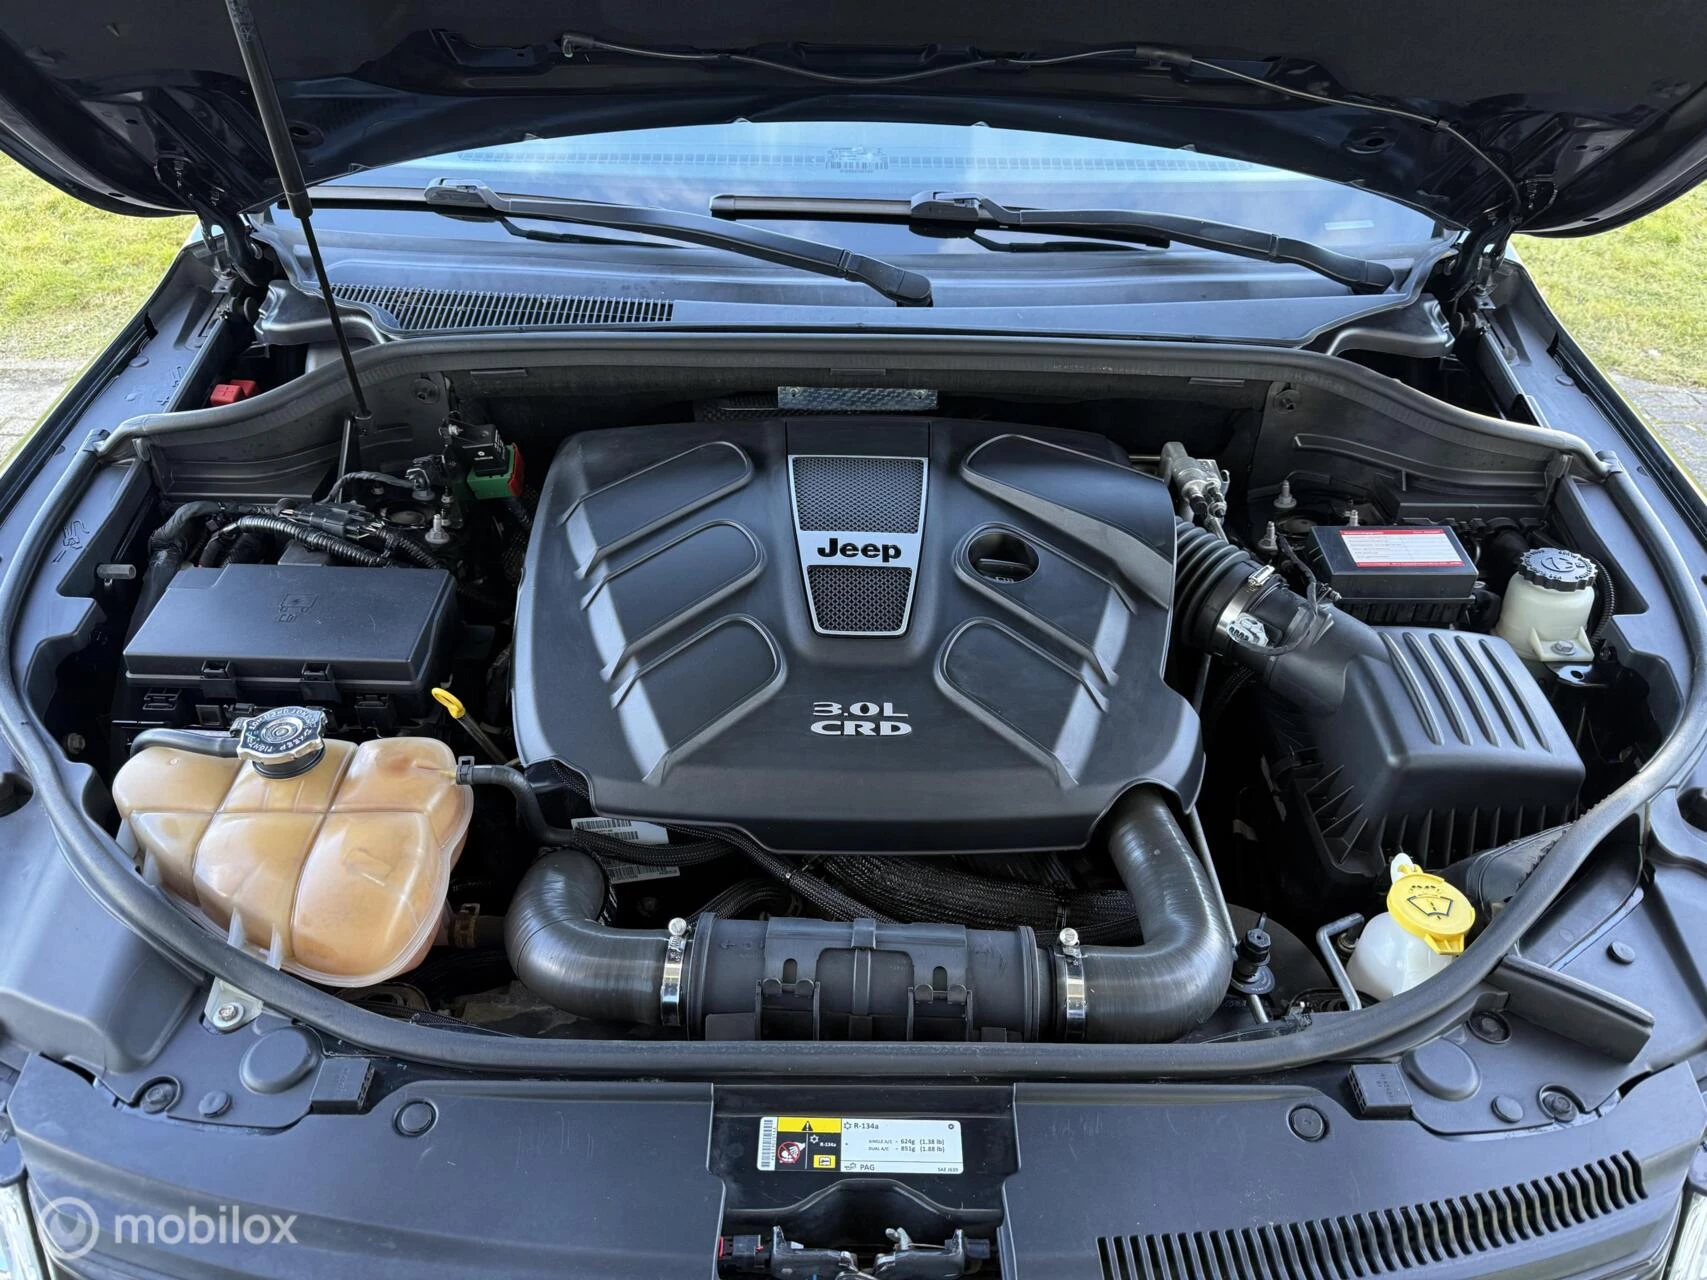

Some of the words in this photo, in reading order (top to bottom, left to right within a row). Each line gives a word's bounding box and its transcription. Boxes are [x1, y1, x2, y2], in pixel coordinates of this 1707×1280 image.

[817, 538, 902, 562] Jeep
[812, 702, 909, 718] 3.0L
[810, 720, 912, 737] CRD
[248, 742, 273, 753] TIGHT
[279, 735, 304, 751] KEEP
[853, 1122, 879, 1130] R-134a
